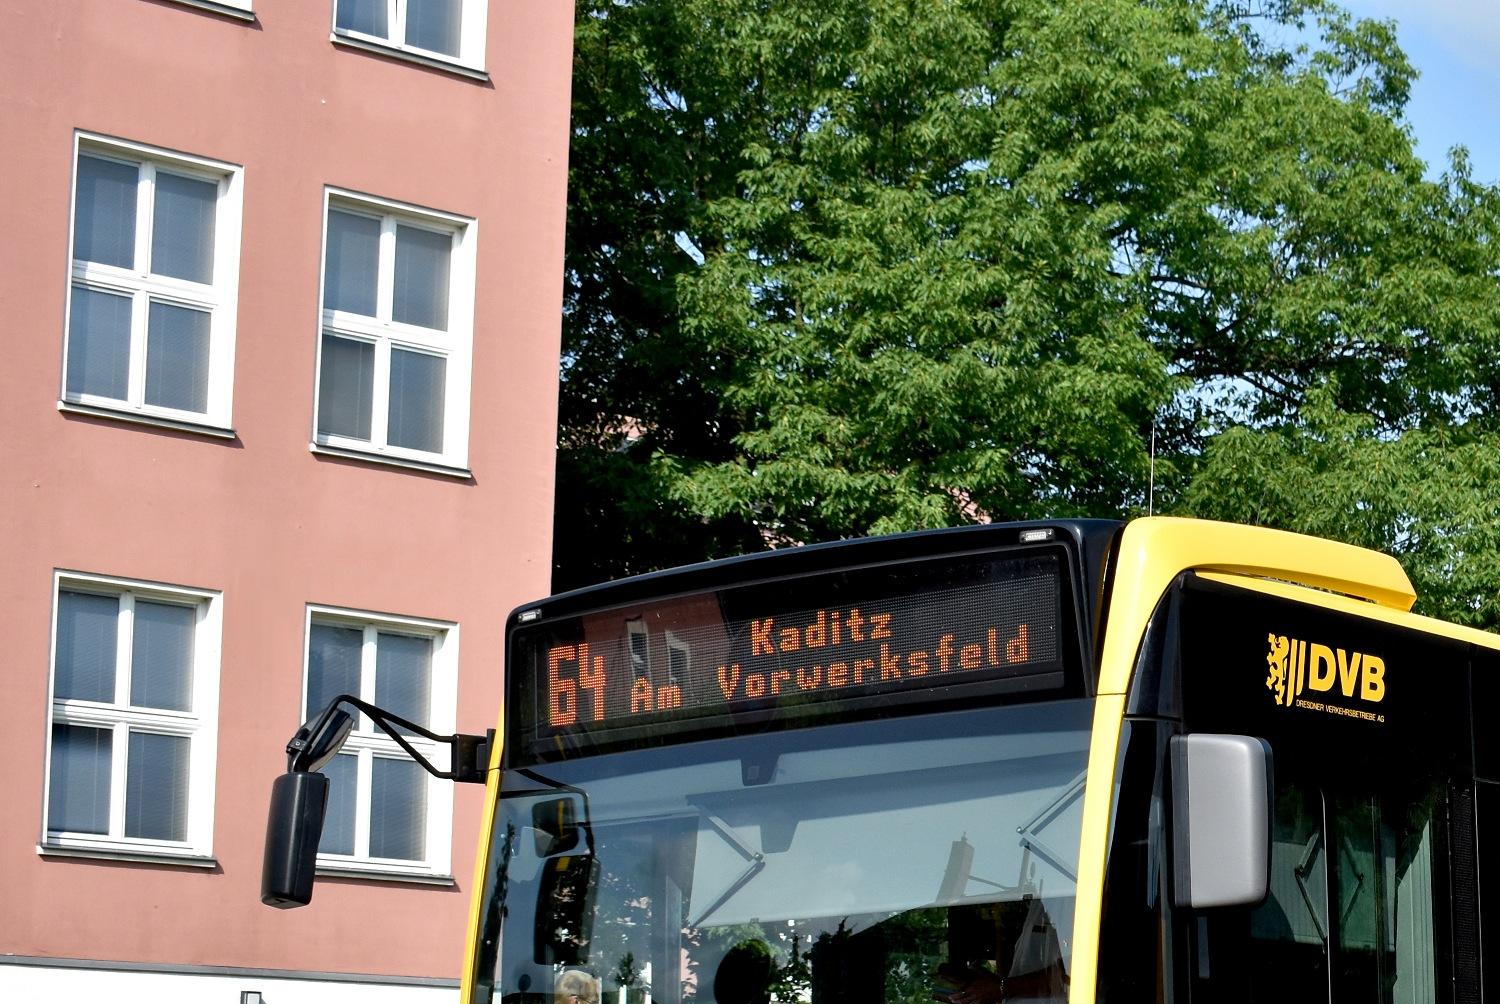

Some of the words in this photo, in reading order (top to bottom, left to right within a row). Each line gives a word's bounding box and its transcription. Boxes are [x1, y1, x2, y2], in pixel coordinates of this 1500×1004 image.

[751, 608, 893, 656] Kaditz
[549, 643, 607, 726] 64
[631, 677, 683, 713] Am
[717, 623, 1029, 700] Vorwerksfeld
[1309, 643, 1385, 702] DVB
[1296, 700, 1324, 711] DRESDNER
[1326, 705, 1376, 721] VERKEHRSBETRIEBE
